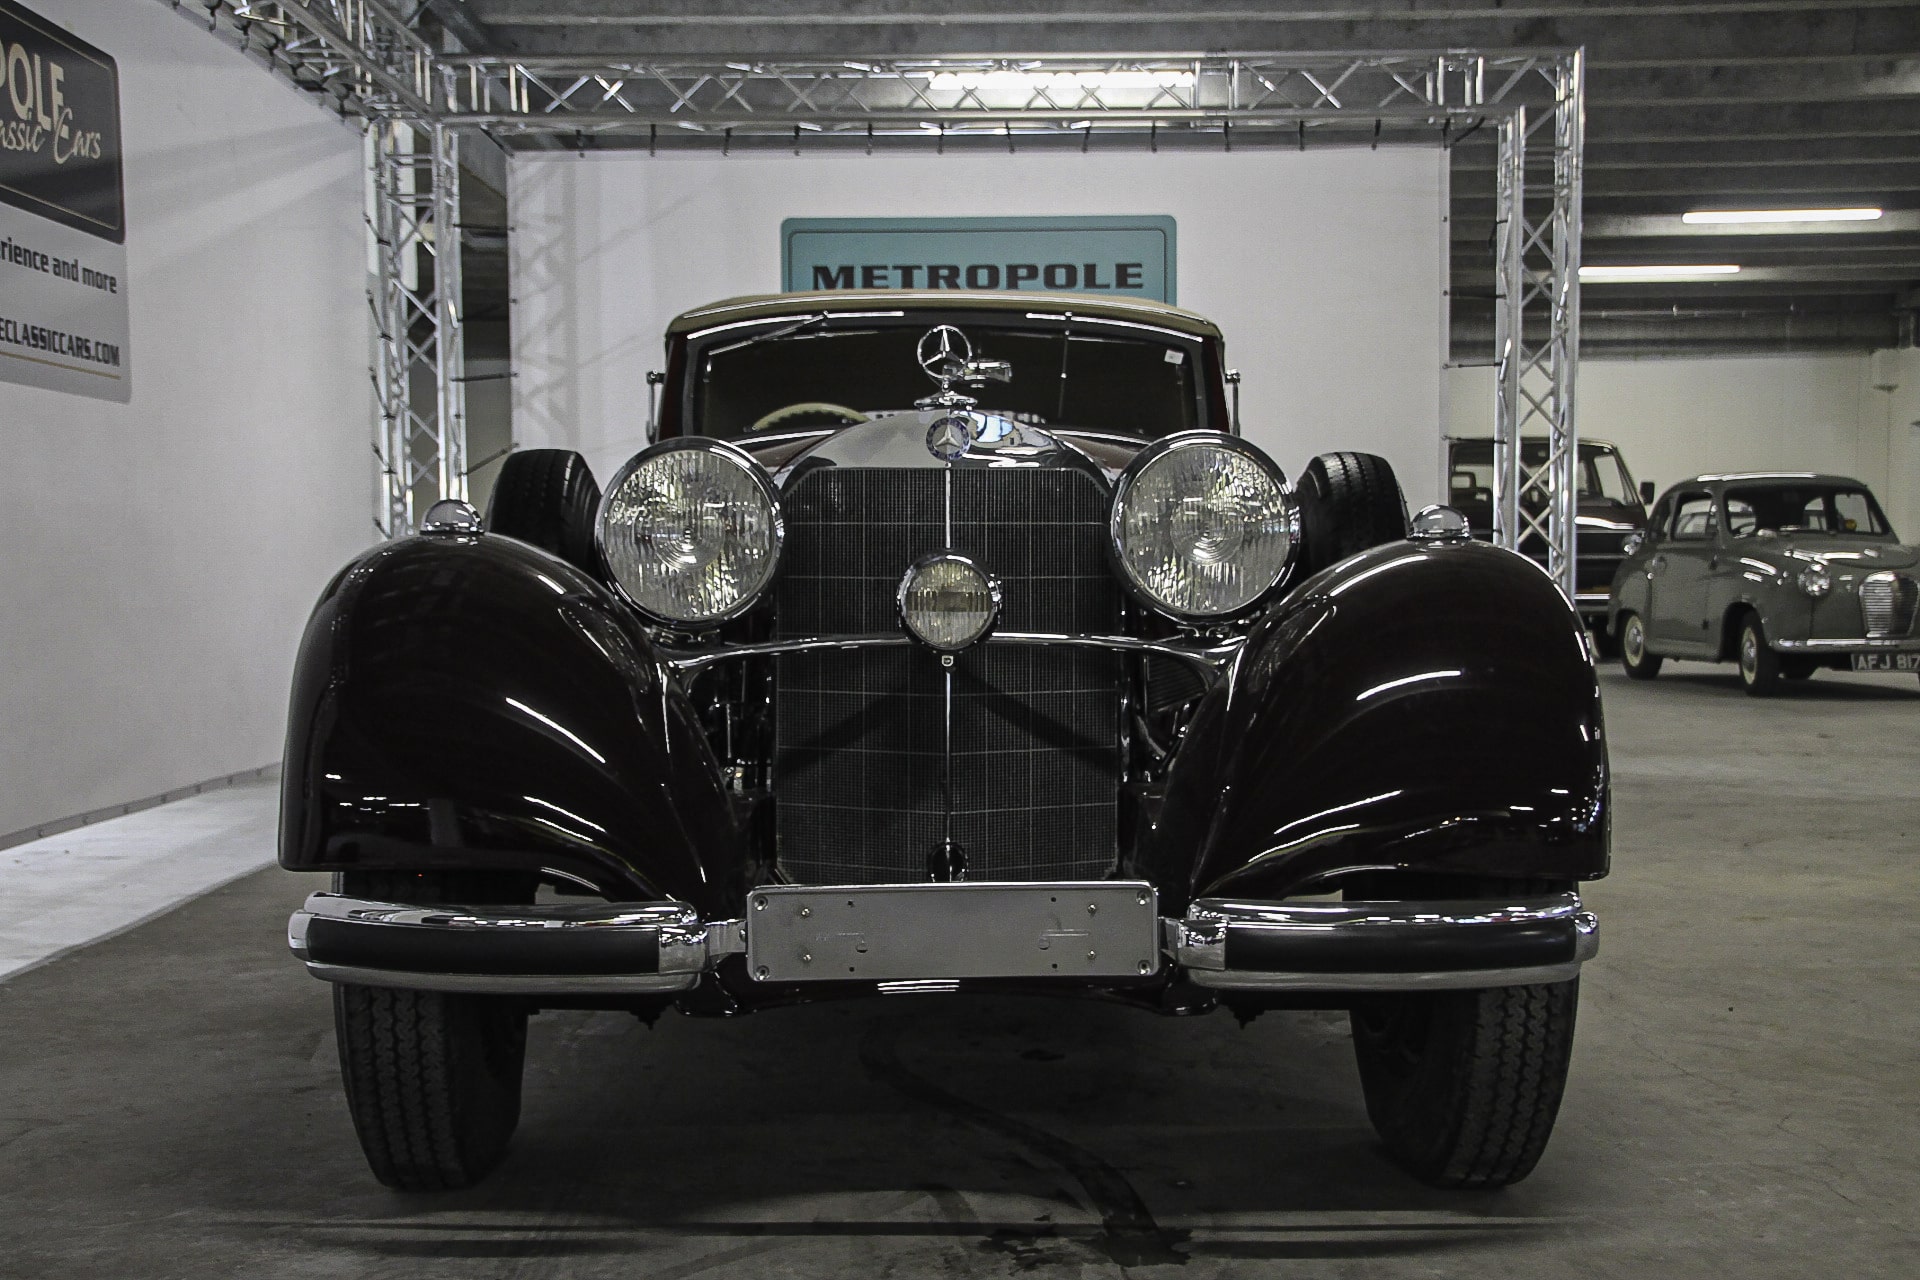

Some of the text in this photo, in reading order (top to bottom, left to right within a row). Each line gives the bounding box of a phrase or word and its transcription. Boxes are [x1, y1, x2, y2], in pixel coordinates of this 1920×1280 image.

[54, 107, 101, 164] Cars
[53, 258, 79, 282] and
[82, 267, 117, 294] more
[812, 263, 1144, 290] METROPOLE
[1857, 653, 1920, 670] AFJ 817
